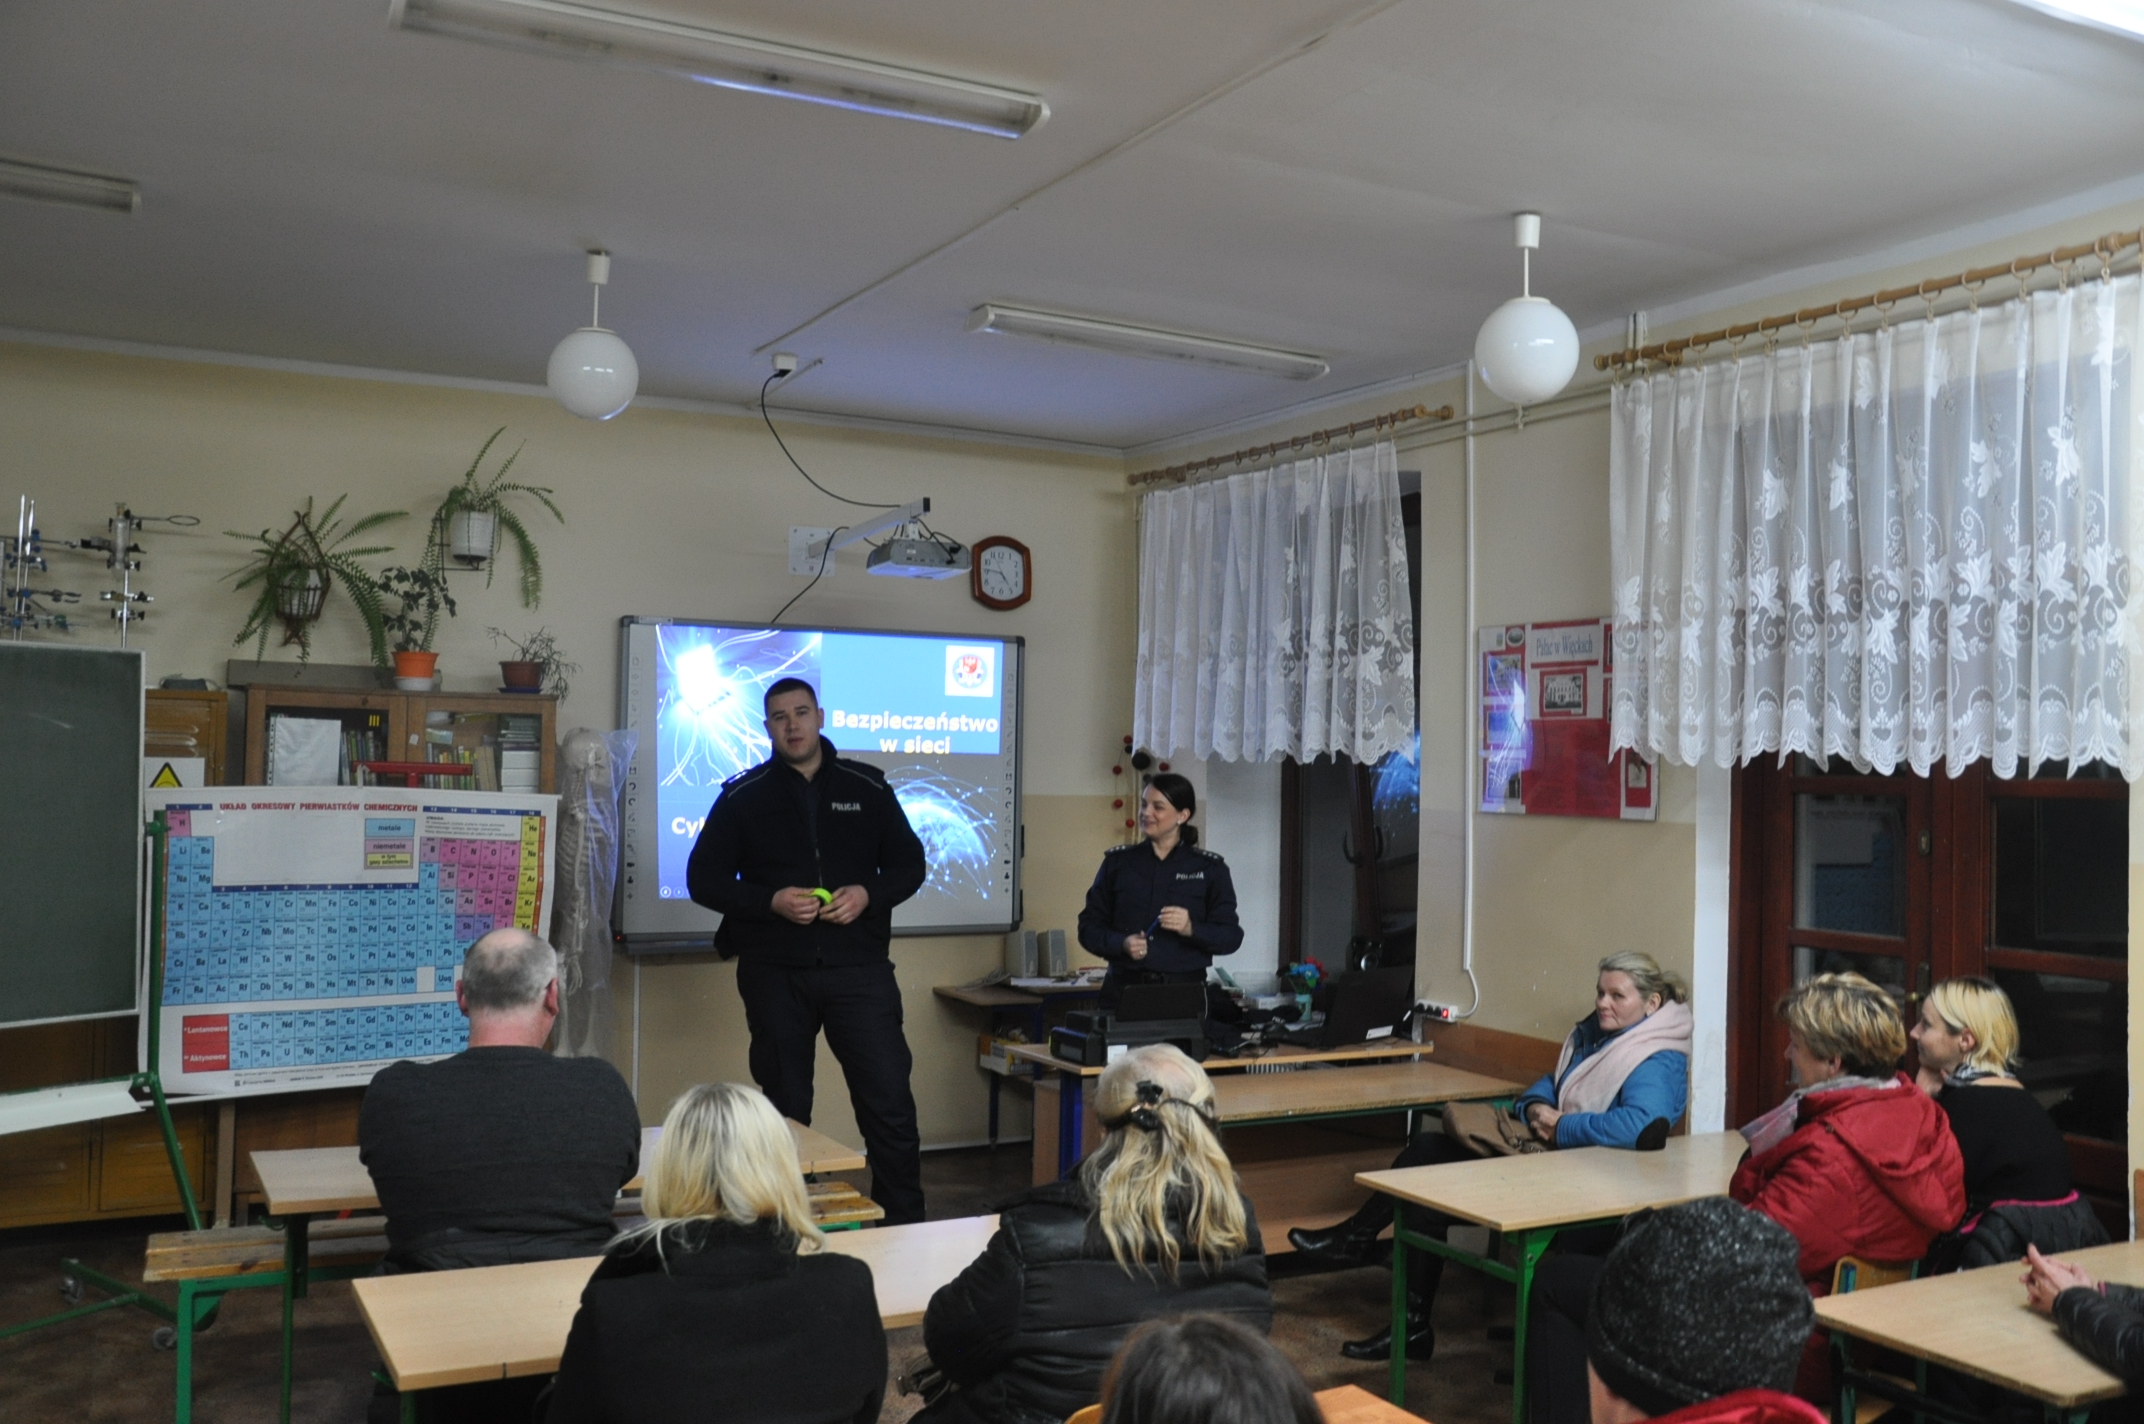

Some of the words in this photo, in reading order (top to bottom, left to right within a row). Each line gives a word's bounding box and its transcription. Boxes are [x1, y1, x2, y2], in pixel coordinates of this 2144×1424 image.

[832, 710, 998, 733] Bezpieczeństwo
[880, 739, 898, 752] w
[904, 736, 950, 754] sieci
[299, 801, 360, 811] PIERWIASTKÓW
[832, 802, 861, 811] POLICJA
[199, 875, 210, 883] Mg
[1176, 872, 1204, 880] POLICJA
[244, 901, 250, 909] Ti
[175, 931, 185, 939] Rb
[387, 925, 396, 933] Ag
[406, 951, 414, 959] Hg
[426, 949, 432, 957] Tl
[173, 987, 180, 995] Fr
[283, 982, 292, 991] Sg
[385, 978, 393, 986] Rg
[405, 1014, 413, 1022] Dy
[304, 1048, 314, 1056] Np
